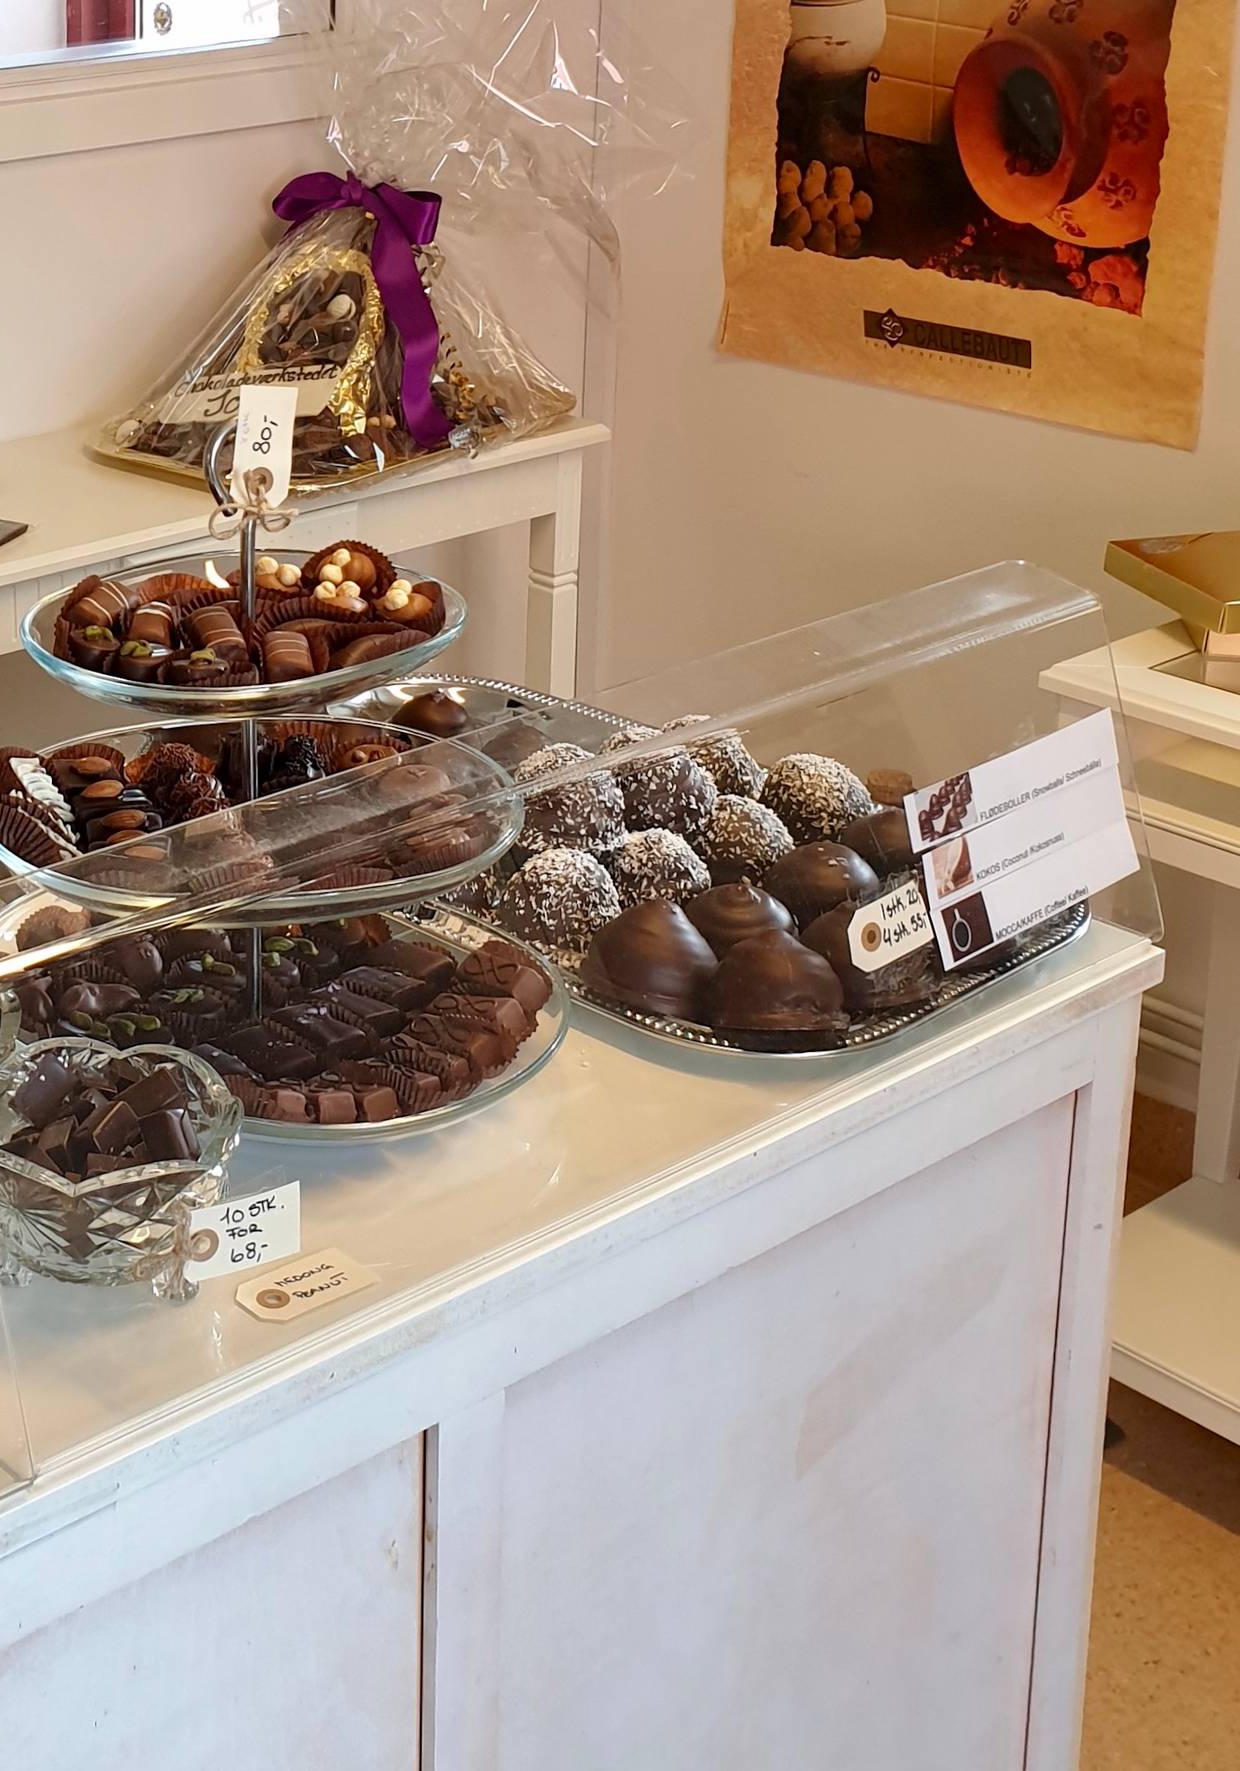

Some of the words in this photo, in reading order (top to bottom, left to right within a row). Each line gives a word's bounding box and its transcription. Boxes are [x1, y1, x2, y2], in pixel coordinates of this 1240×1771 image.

[914, 323, 1023, 361] CALLEBAUT
[979, 791, 1031, 822] FLØDEBOLLER
[976, 862, 1001, 881] KOKOS
[220, 1207, 245, 1226] 10
[225, 1223, 263, 1240] FOR
[230, 1242, 269, 1264] 68,-
[292, 1271, 349, 1299] PEANUT
